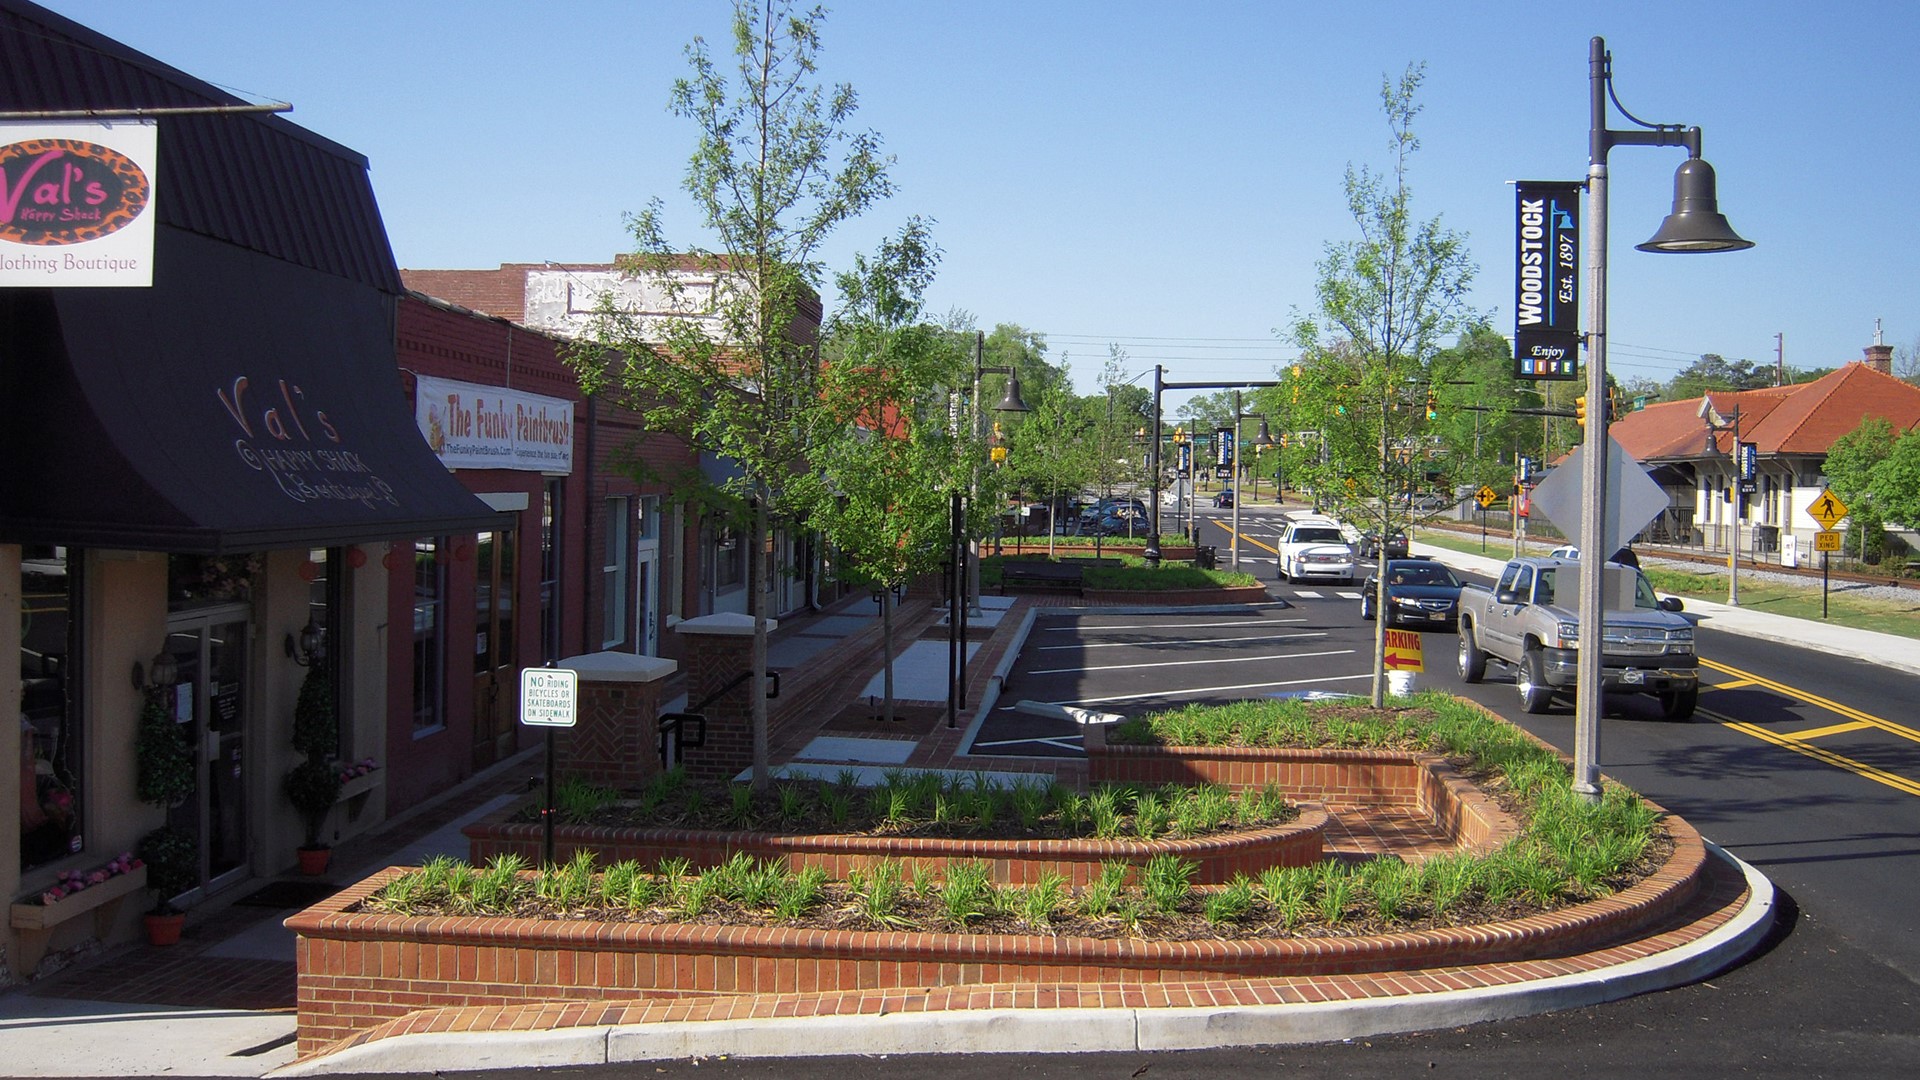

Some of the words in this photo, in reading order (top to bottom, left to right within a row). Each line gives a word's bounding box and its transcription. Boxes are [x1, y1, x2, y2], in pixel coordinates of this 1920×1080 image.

[0, 150, 108, 223] Val's
[59, 207, 101, 222] Shack
[1518, 199, 1544, 326] WOODSTOCK
[1559, 234, 1574, 270] 1897
[0, 254, 58, 274] lothing
[63, 253, 138, 274] Boutique
[1558, 275, 1573, 304] Est.
[1531, 345, 1565, 360] Enjoy
[1523, 360, 1571, 374] LIFE
[217, 376, 341, 443] Val's
[447, 393, 472, 439] The
[476, 398, 513, 446] Funky
[516, 403, 569, 446] Paintbrush
[261, 449, 322, 472] HAPPY
[317, 449, 373, 473] SHACK
[1384, 630, 1421, 651] ARKING
[530, 676, 544, 688] NO
[547, 680, 569, 688] RIDING
[527, 699, 571, 708] SKATEBOARDS
[528, 689, 559, 698] BICYCLES
[561, 690, 570, 698] OR
[527, 708, 537, 717] ON
[539, 709, 570, 718] SIDEWALK
